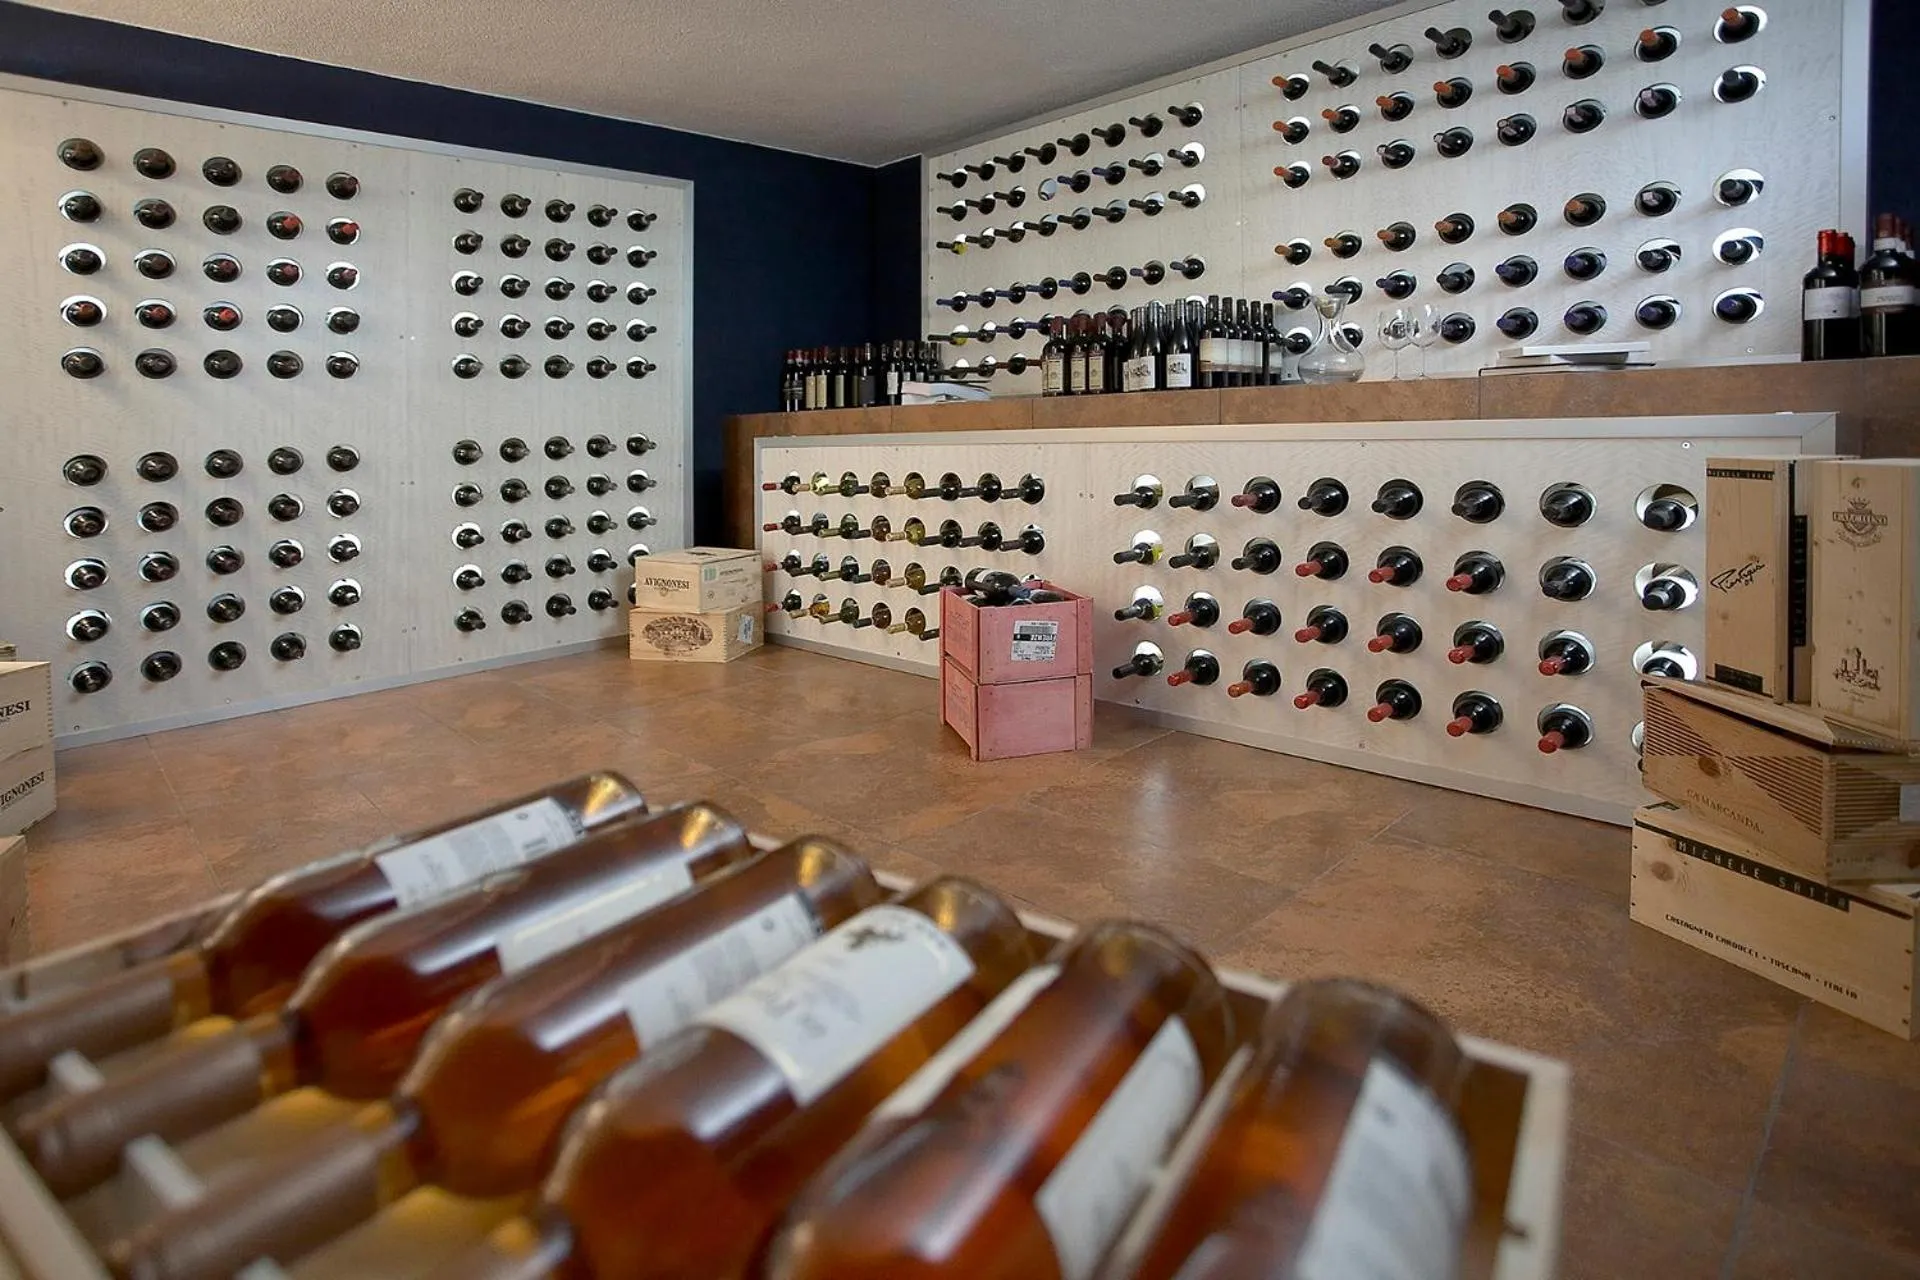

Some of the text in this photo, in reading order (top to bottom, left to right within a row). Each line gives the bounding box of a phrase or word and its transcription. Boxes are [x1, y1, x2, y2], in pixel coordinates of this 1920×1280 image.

[644, 576, 690, 590] AVIGNONESI
[1678, 841, 1761, 880] MICHELE
[1665, 913, 1714, 939] CASTAGNETO
[1715, 935, 1759, 958] CARDUCCI
[1770, 957, 1811, 980] TOSCANA
